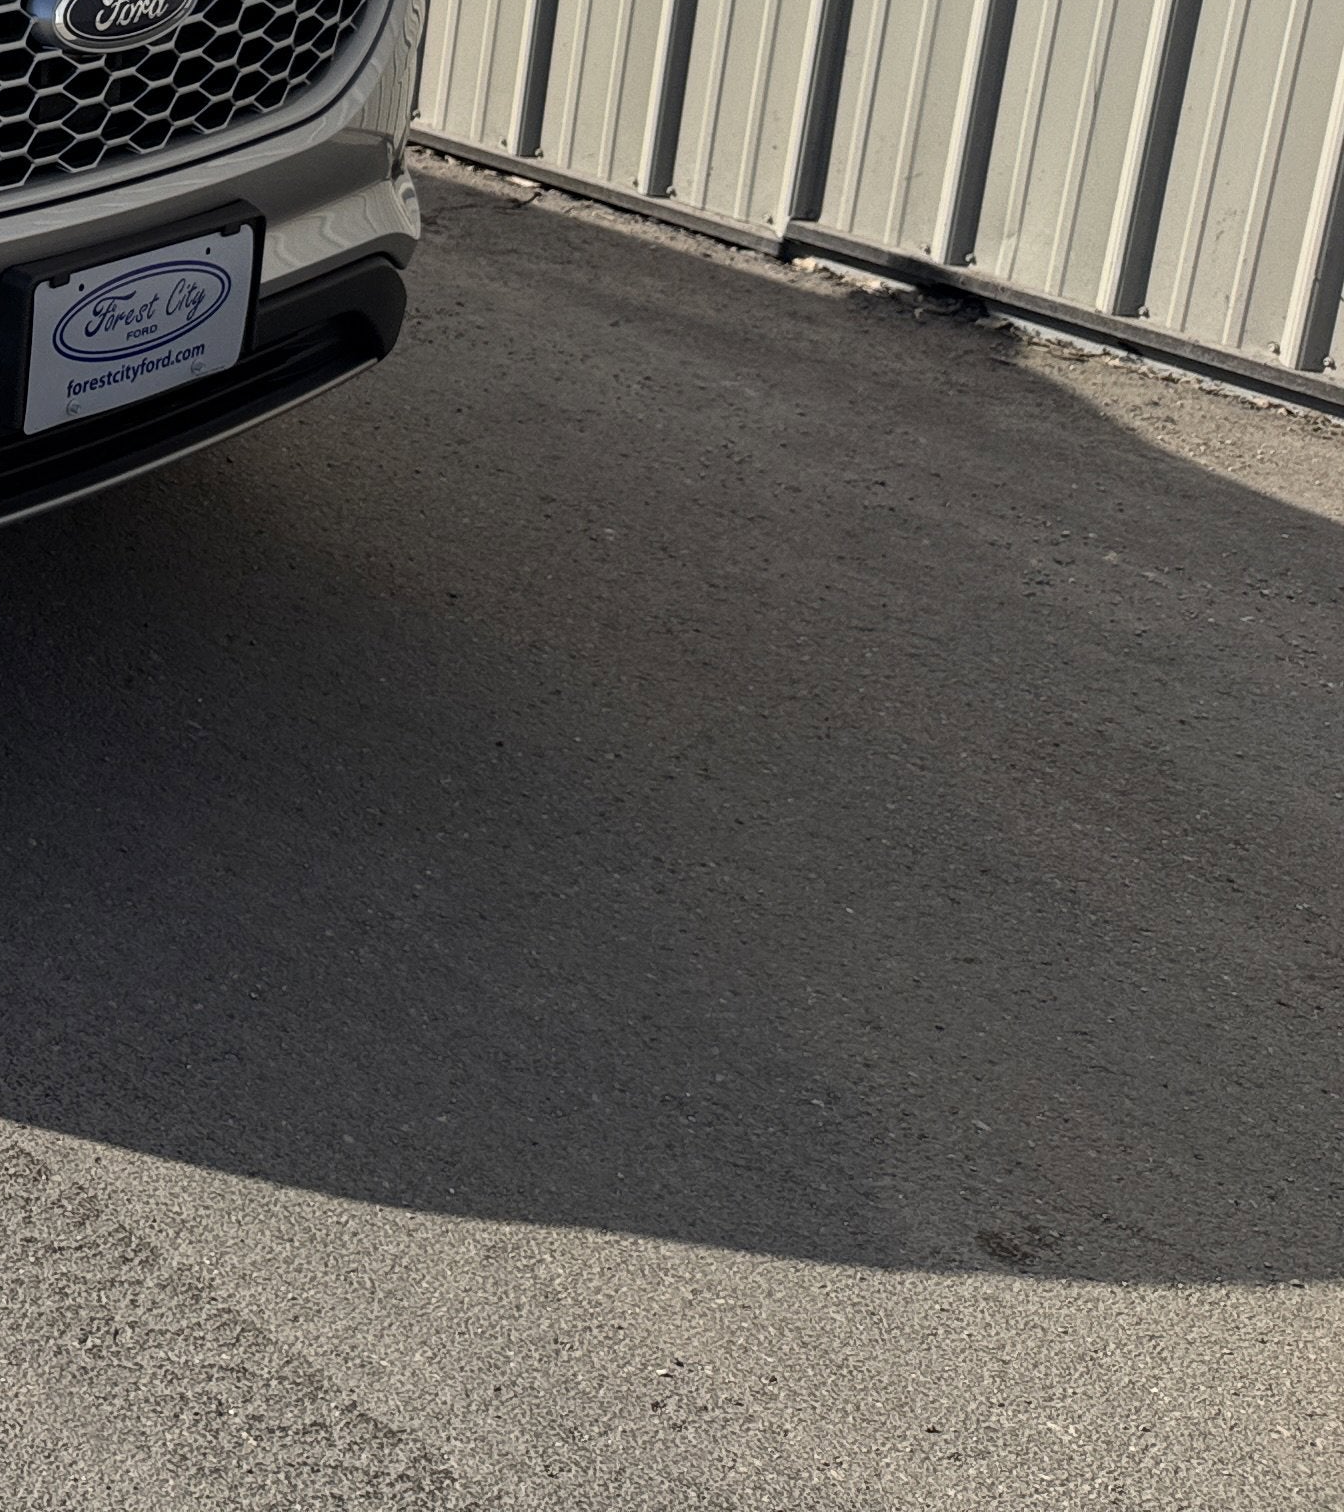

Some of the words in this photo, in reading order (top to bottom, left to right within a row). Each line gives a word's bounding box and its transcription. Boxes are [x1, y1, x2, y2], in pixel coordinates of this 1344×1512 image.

[84, 289, 160, 338] Forest
[165, 278, 206, 321] City
[126, 324, 158, 341] FORD
[66, 342, 205, 398] forestcityford.com
